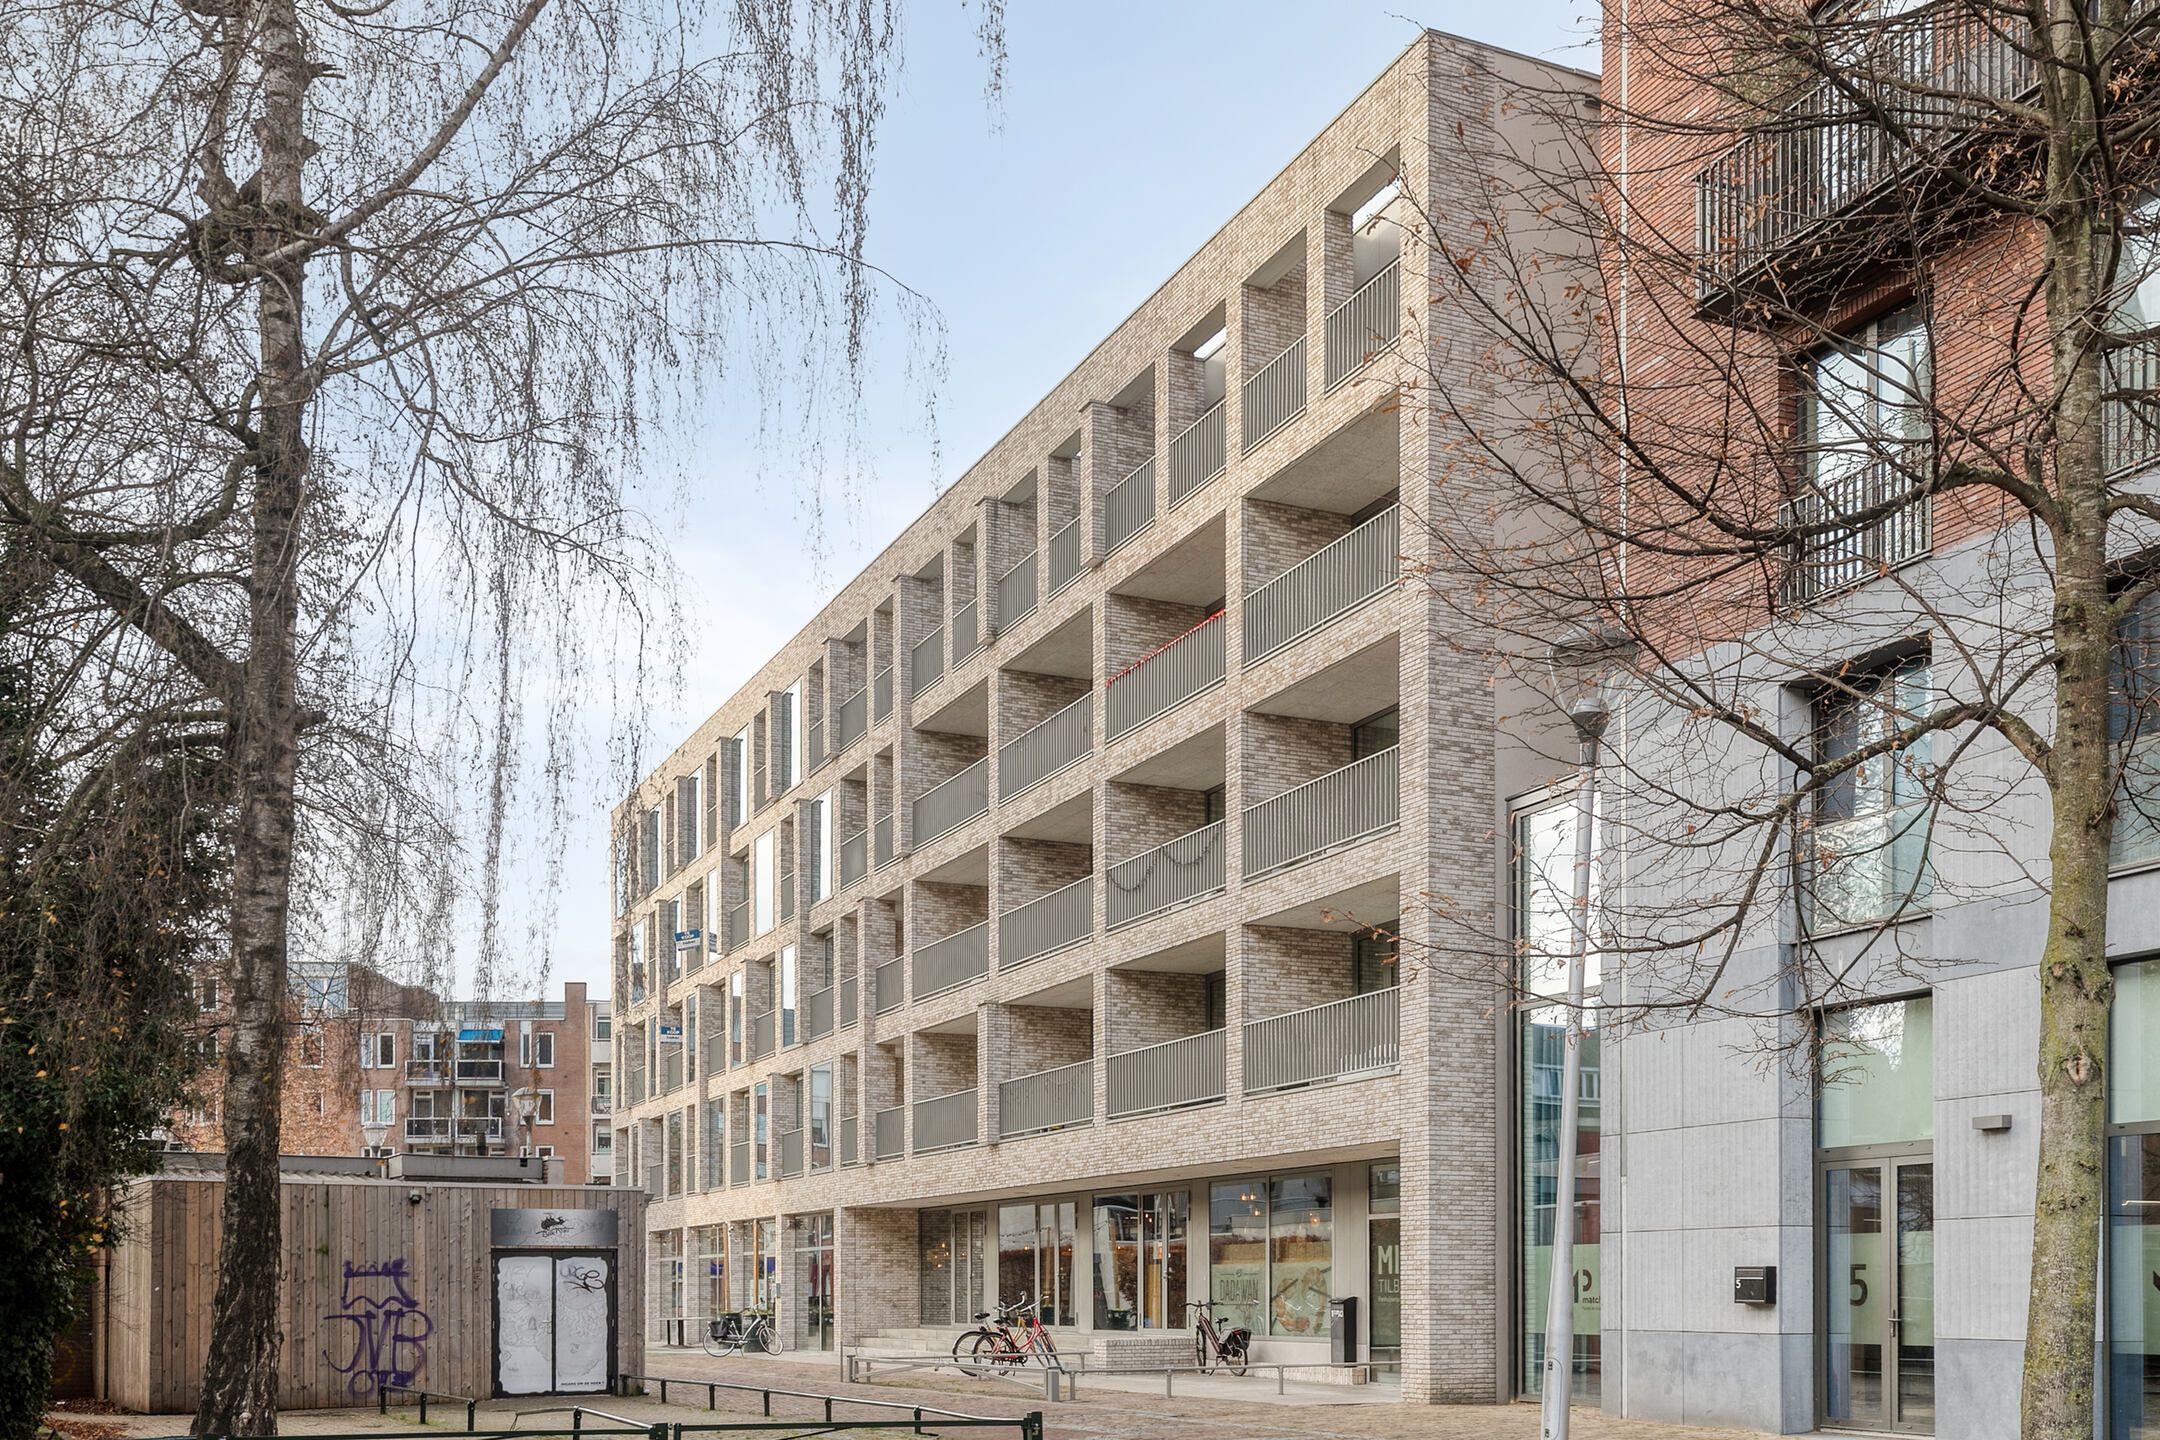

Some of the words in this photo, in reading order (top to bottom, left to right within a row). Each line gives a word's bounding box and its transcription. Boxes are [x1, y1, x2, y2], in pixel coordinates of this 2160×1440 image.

[1220, 1279, 1259, 1302] DADAWAN
[1736, 1279, 1742, 1289] 5
[1850, 1264, 1868, 1306] 5
